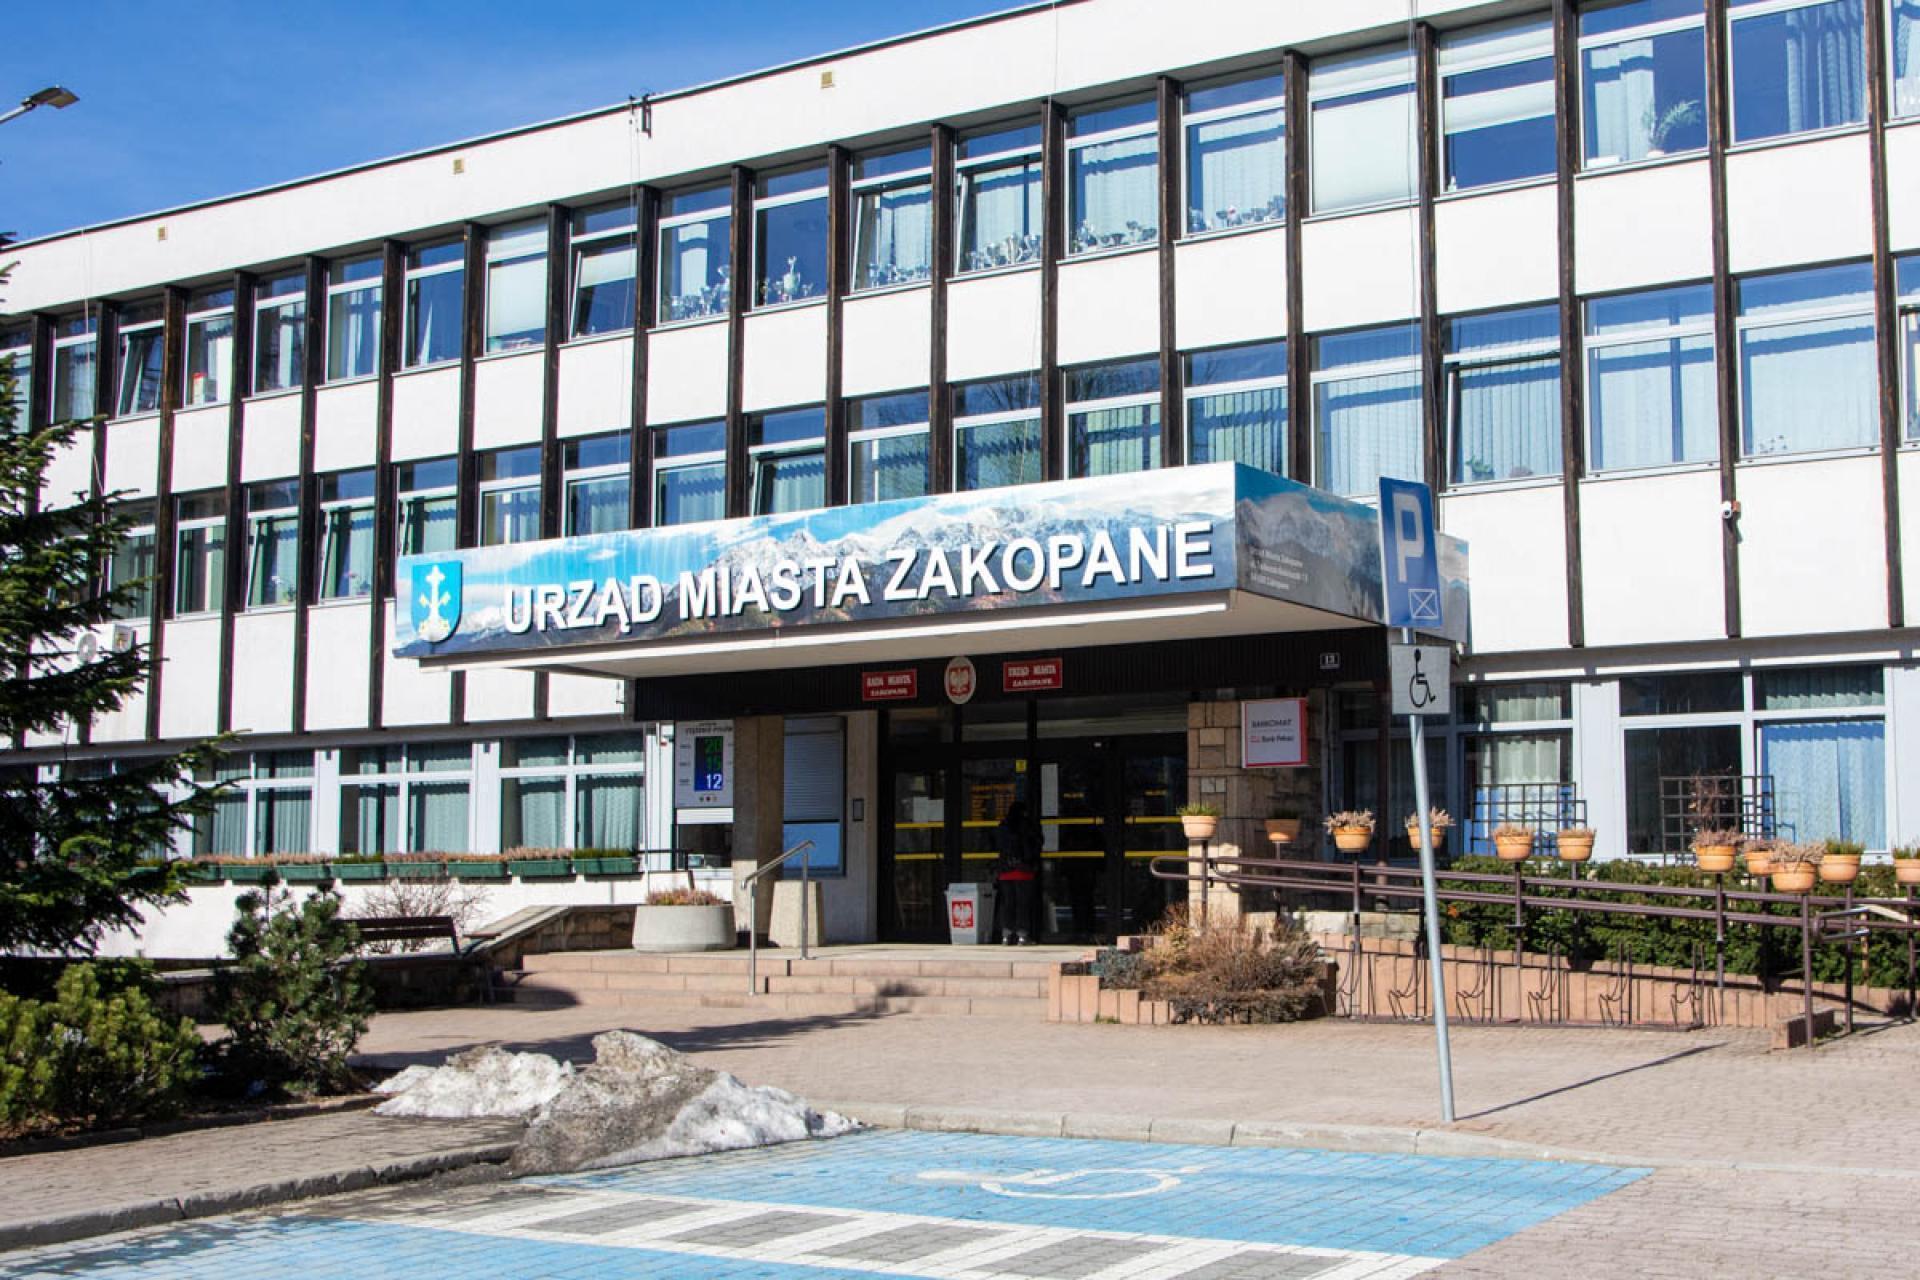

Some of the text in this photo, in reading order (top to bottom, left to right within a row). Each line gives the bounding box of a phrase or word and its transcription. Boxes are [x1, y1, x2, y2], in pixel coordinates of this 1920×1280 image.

[1392, 492, 1425, 583] P
[504, 520, 1215, 634] URZĄD MIASTA ZAKOPANE
[1251, 718, 1292, 728] BANKOMAT
[706, 774, 722, 790] 12
